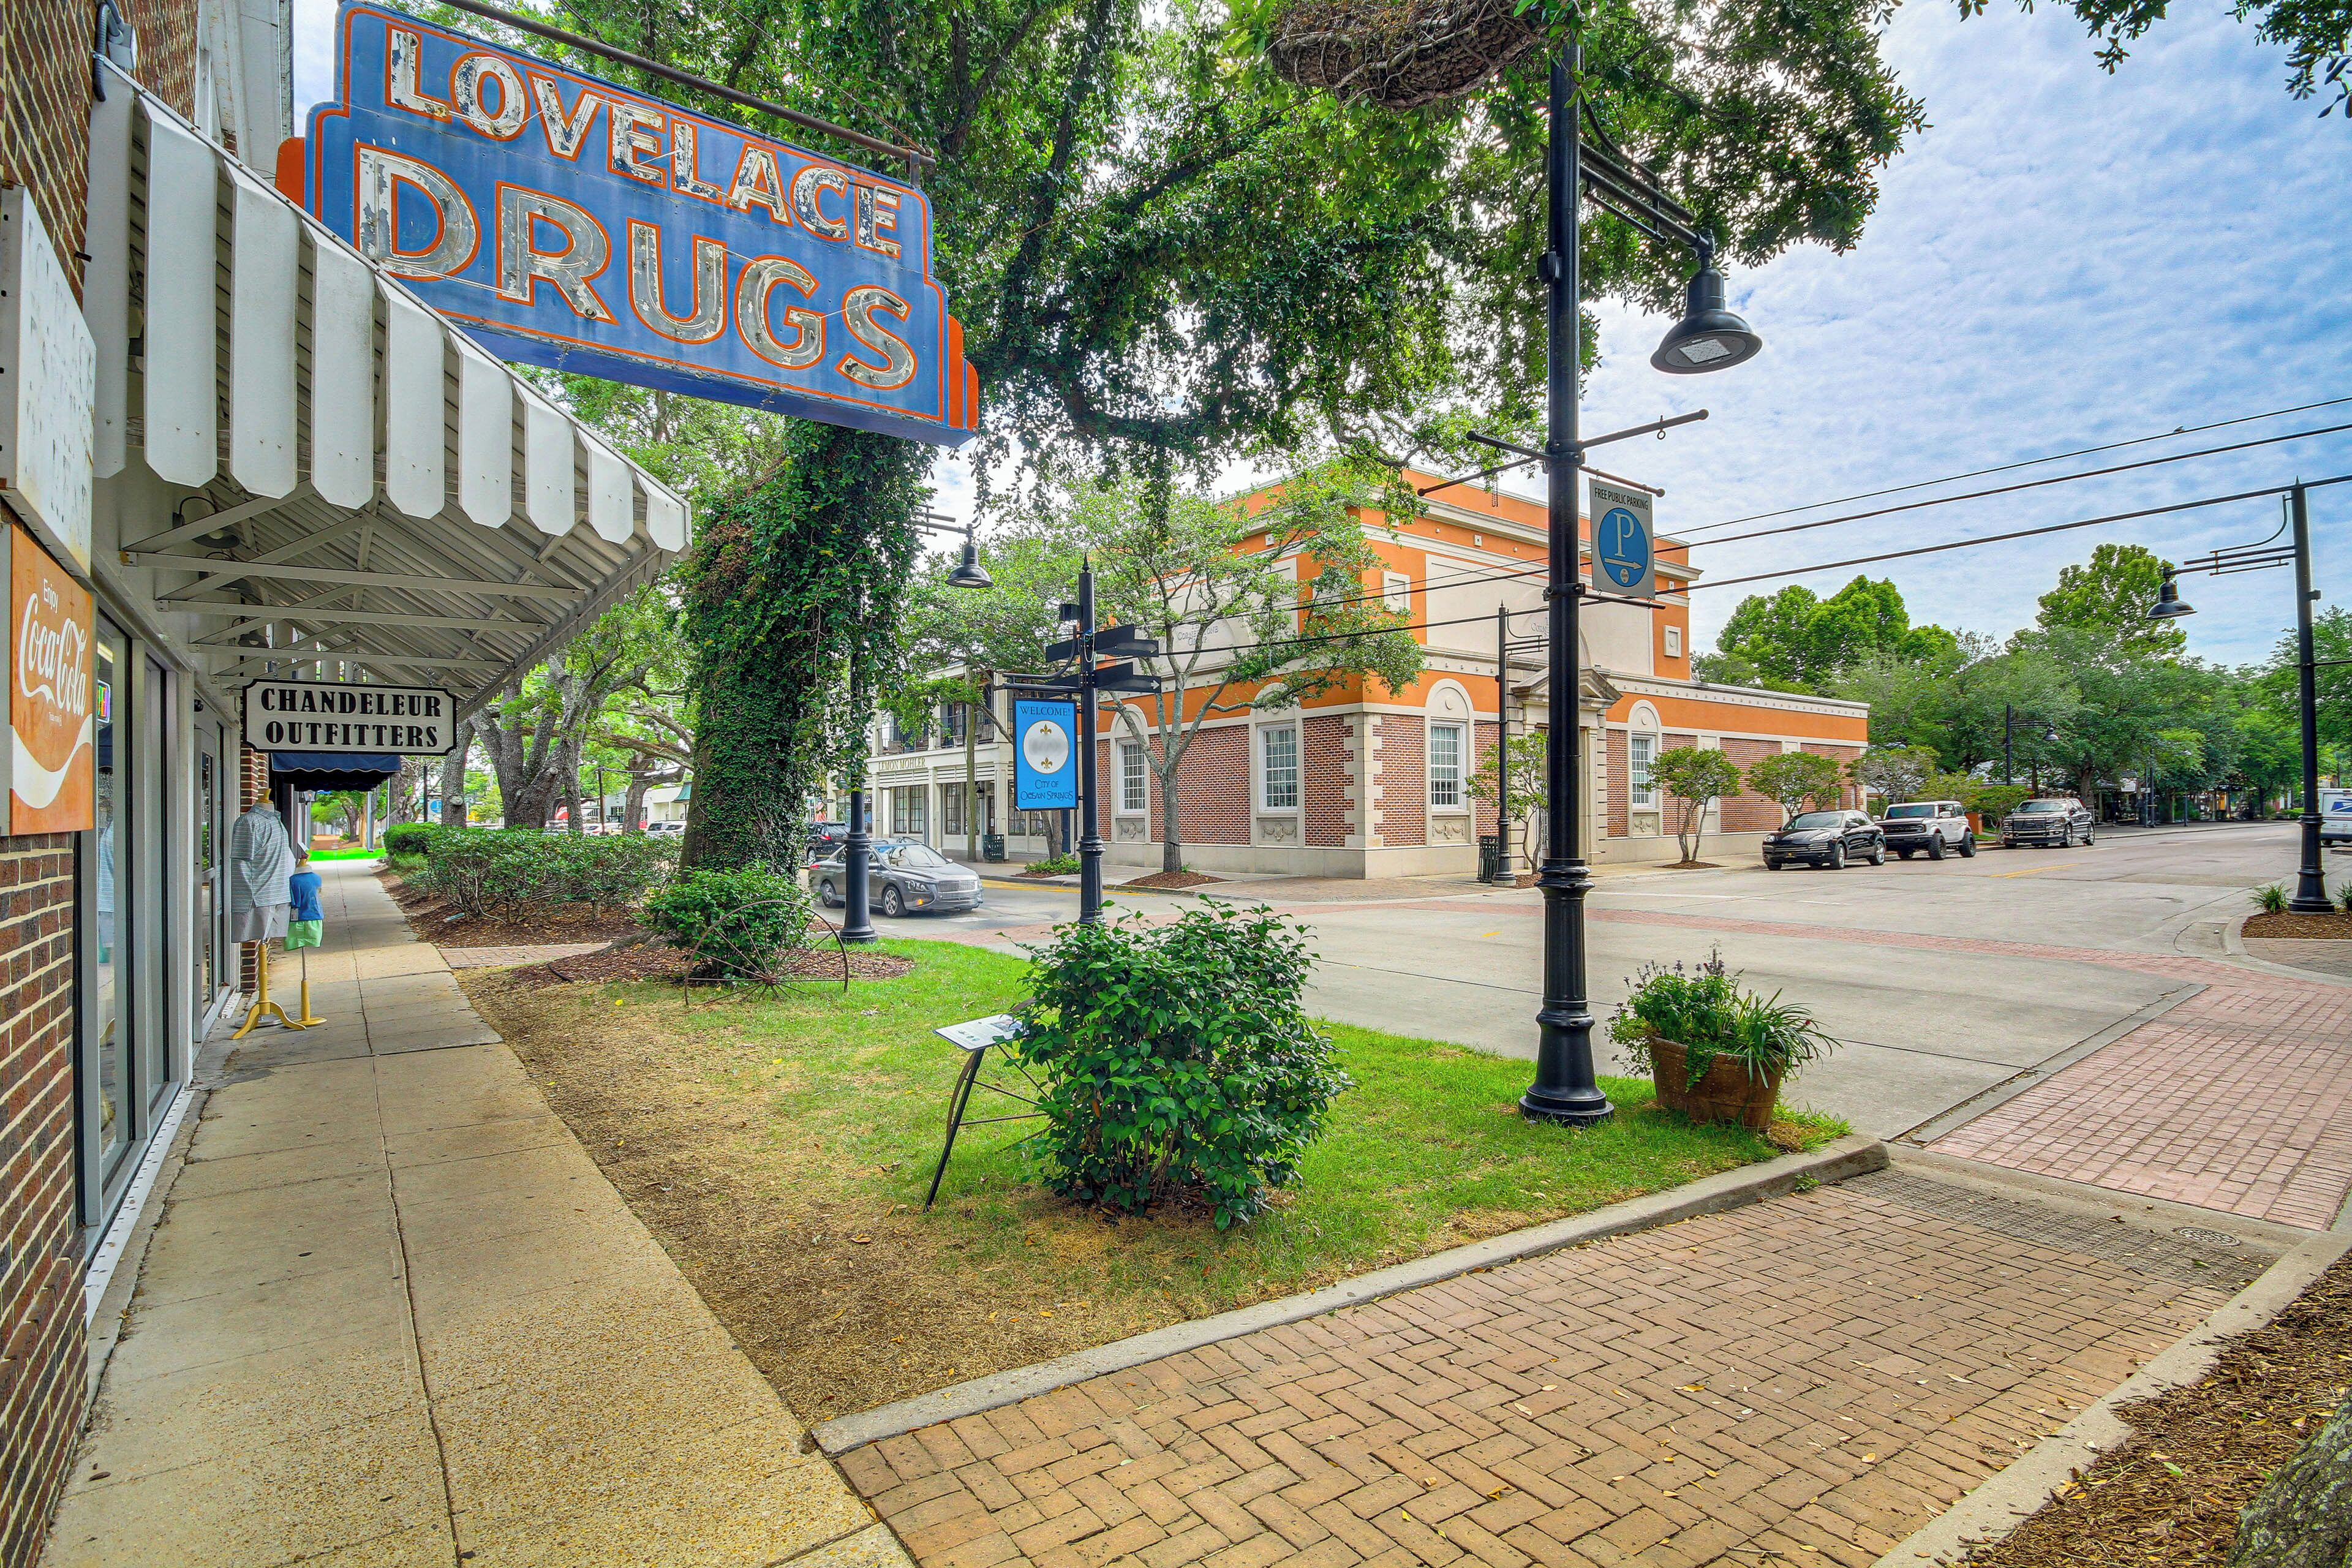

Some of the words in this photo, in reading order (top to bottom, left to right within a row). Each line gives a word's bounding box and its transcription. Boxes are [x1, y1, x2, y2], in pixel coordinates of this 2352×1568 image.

[385, 23, 902, 258] LOVELACE
[354, 143, 917, 391] DRUGS
[1594, 488, 1608, 500] FREE
[1608, 491, 1626, 505] PUBLIC
[1627, 496, 1648, 510] PARKING
[1613, 512, 1634, 557] P
[43, 578, 59, 614] Enjoy
[19, 592, 88, 717] Coca-Cola
[261, 688, 441, 717] CHANDELEUR
[1019, 706, 1071, 716] WELCOME!
[265, 721, 439, 747] OUTFITTERS
[878, 760, 899, 771] LEMON
[900, 757, 926, 770] MOHLER
